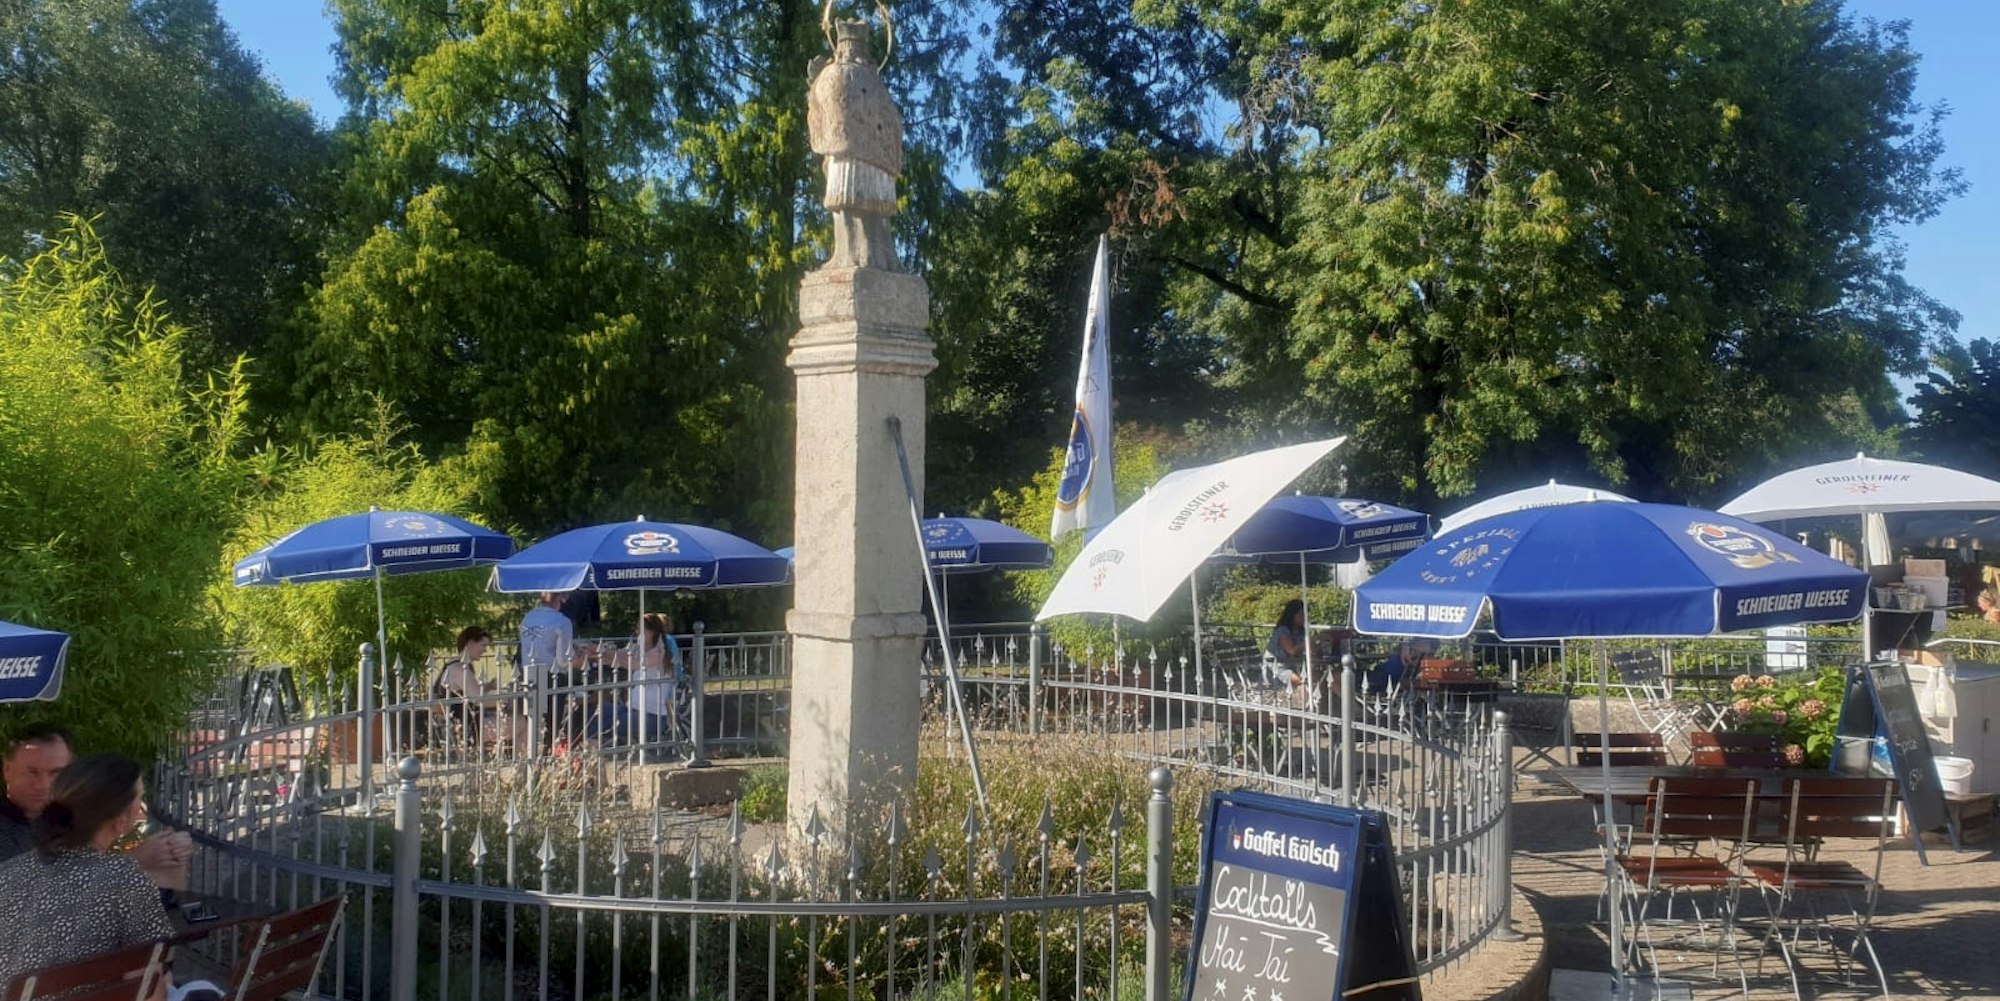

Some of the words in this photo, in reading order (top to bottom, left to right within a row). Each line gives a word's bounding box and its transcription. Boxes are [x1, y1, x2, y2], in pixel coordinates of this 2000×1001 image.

[1815, 474, 1911, 485] GEROLSTEINER
[1168, 480, 1230, 532] GEROLSTEINER
[381, 546, 429, 558] SCHNEIDER
[429, 543, 461, 554] WEISSE
[607, 568, 662, 580] SCHNEIDER
[664, 566, 701, 578] WEISSE
[1370, 603, 1426, 621] SCHNEIDER
[1428, 604, 1468, 623] WEISSE
[1736, 592, 1804, 616] SCHNEIDER
[1804, 589, 1850, 608] WEISSE
[0, 656, 42, 679] EISSE
[1243, 827, 1286, 858] Gaffel
[1288, 836, 1340, 872] Kölsch
[1214, 865, 1317, 930] Cocktails
[1201, 924, 1249, 972] Mai
[1254, 931, 1296, 983] Tai
